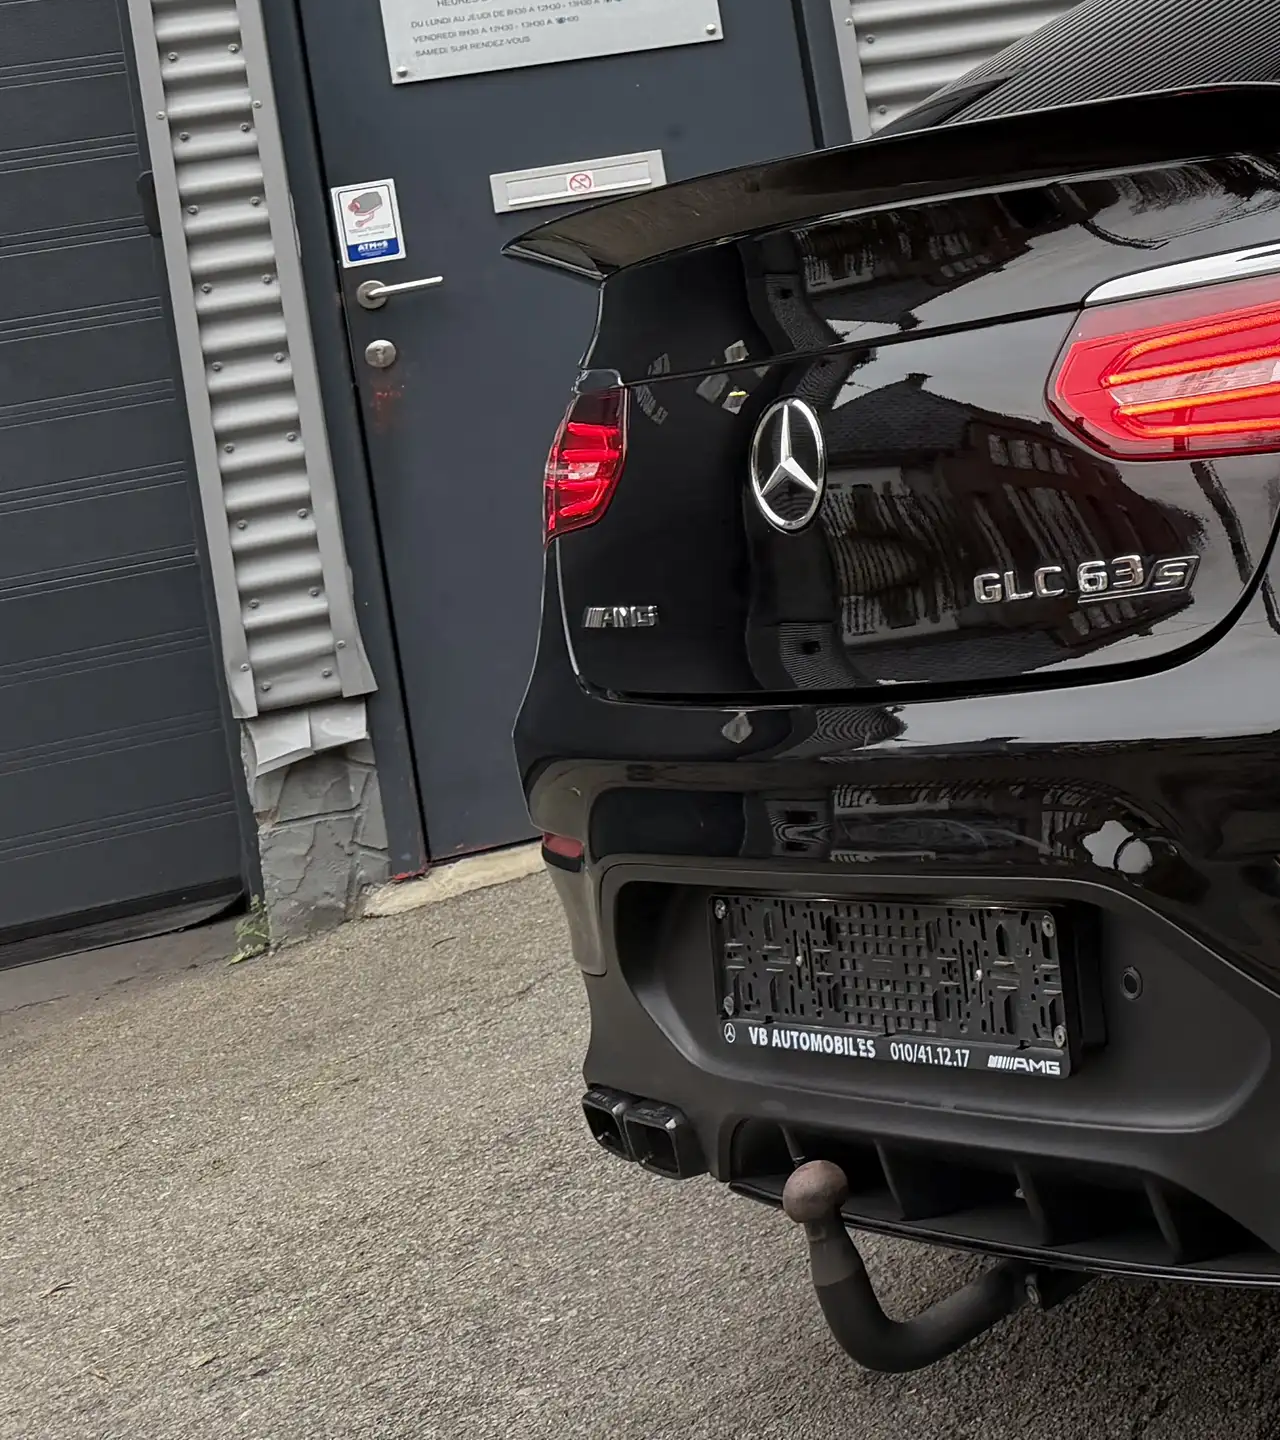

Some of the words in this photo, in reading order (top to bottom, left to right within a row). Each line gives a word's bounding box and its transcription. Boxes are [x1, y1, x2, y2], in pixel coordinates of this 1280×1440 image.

[425, 17, 451, 27] LUNDI
[467, 12, 492, 22] JEUDI
[412, 31, 457, 43] VENDREDI
[415, 46, 448, 58] SAMEDI
[450, 43, 469, 53] SUR
[972, 565, 1065, 604] GLC
[748, 1025, 769, 1047] VB
[771, 1029, 877, 1059] AUTOMOBILES
[889, 1041, 971, 1068] 010/41.12.17
